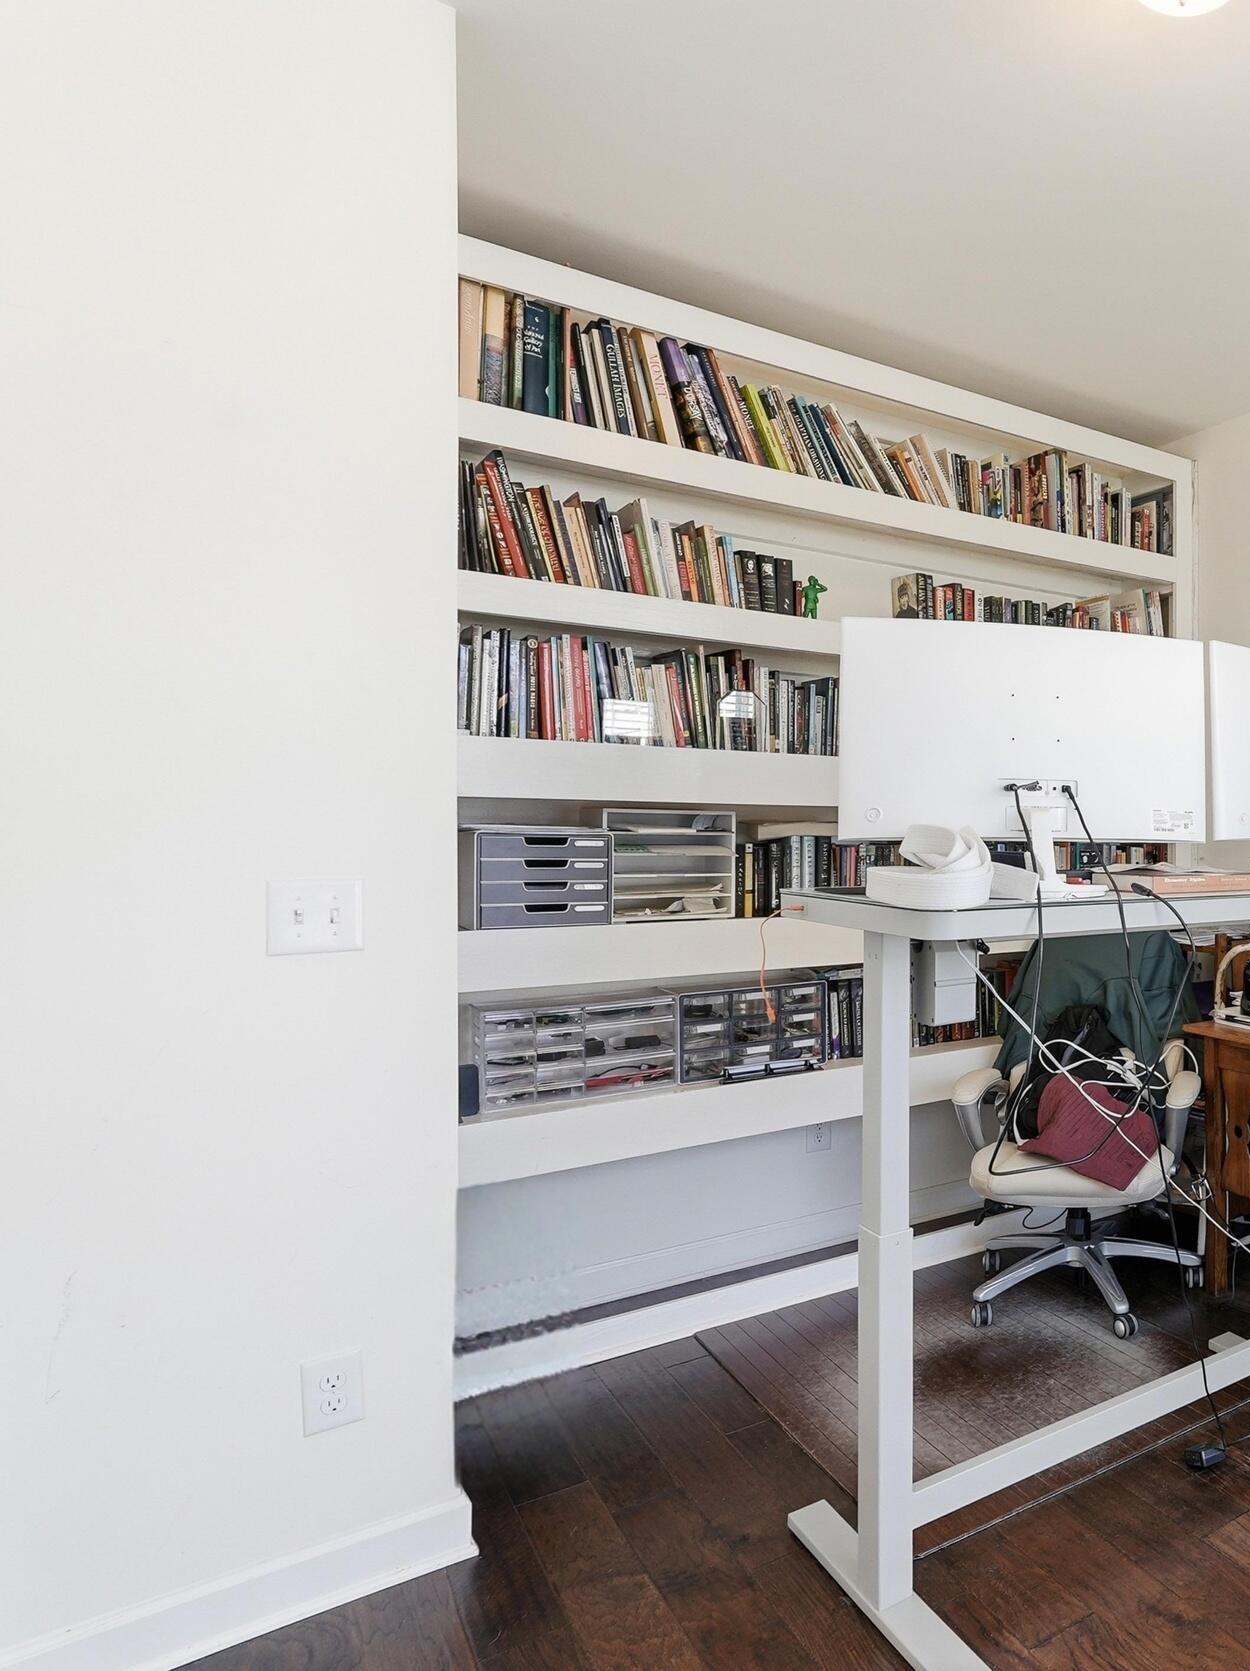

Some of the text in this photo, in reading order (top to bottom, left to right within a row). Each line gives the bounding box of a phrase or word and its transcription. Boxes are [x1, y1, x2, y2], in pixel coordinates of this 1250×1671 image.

[605, 344, 621, 382] GULLAH
[614, 382, 626, 419] IMAGES
[648, 354, 668, 399] MONET
[738, 401, 755, 431] MONET
